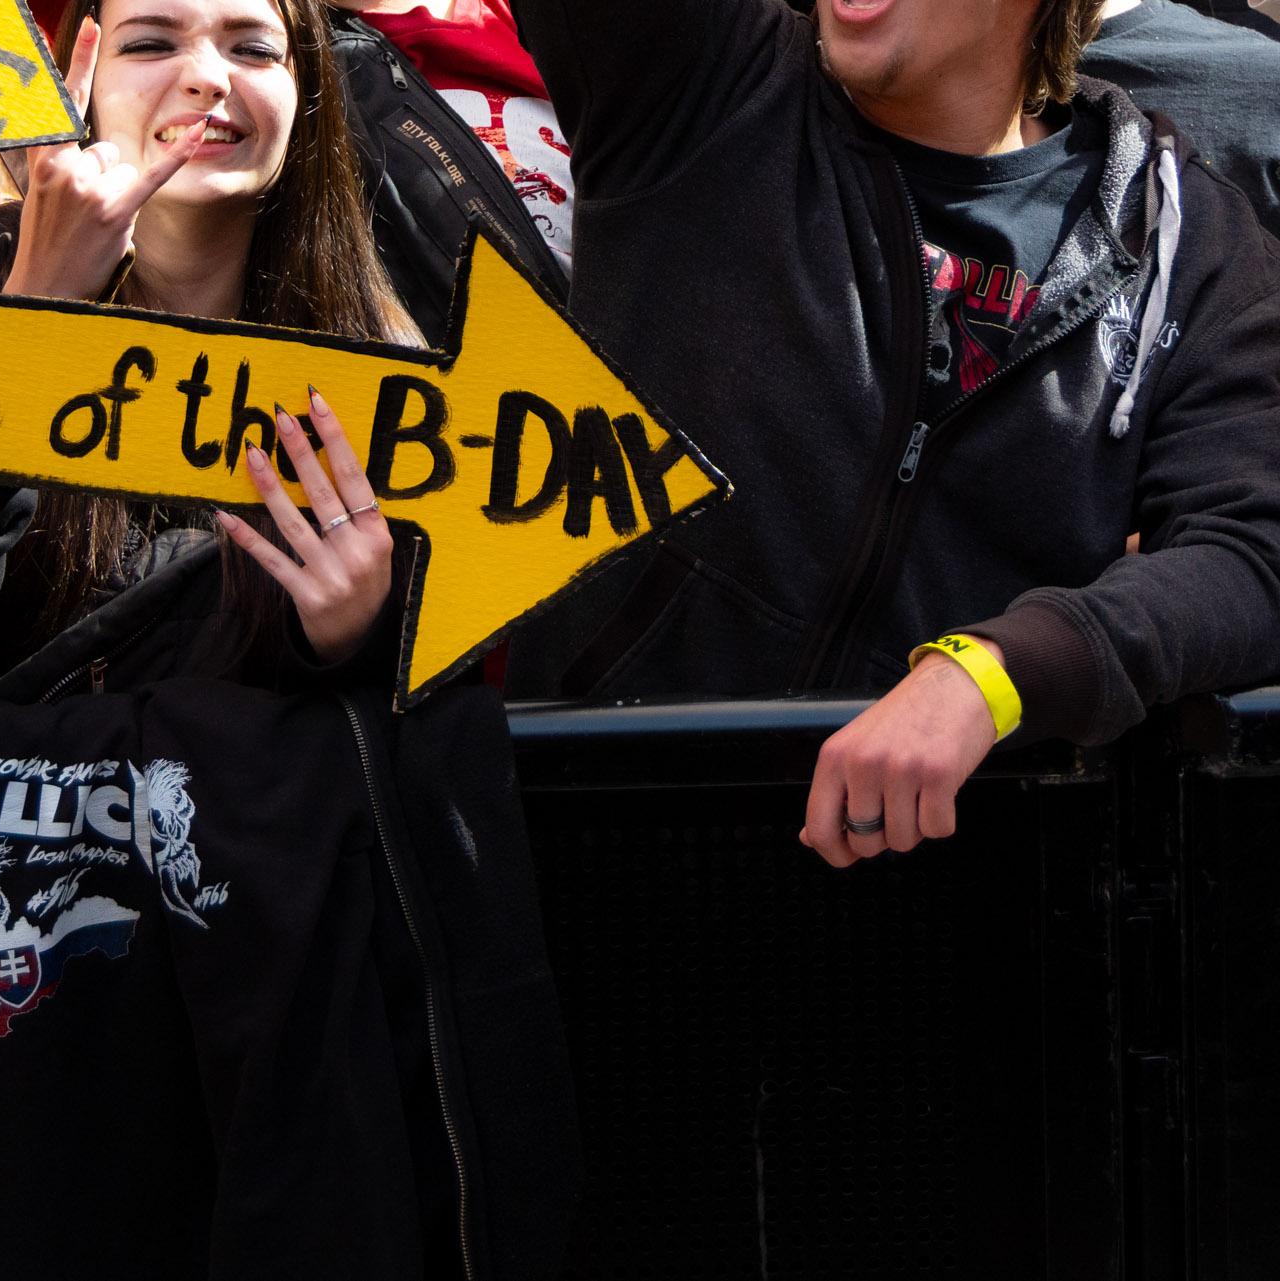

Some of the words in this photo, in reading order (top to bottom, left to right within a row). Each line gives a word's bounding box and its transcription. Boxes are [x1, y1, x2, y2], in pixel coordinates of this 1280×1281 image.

[402, 120, 426, 139] CITY
[423, 135, 465, 187] FOLKLORE
[50, 345, 154, 460] of
[366, 373, 692, 538] B-DAY
